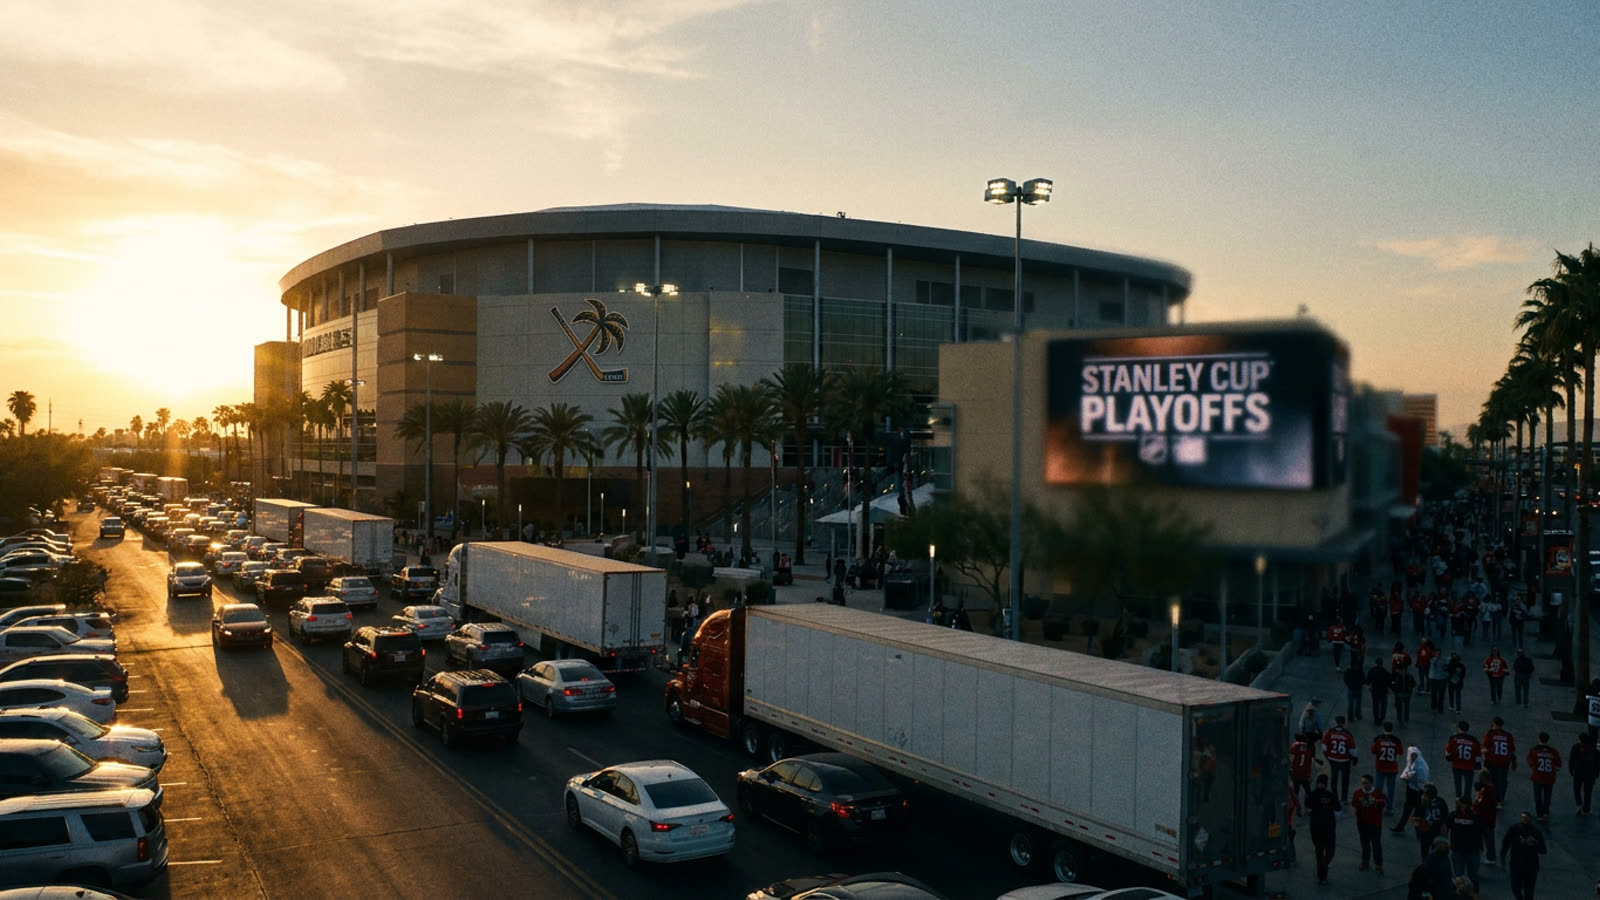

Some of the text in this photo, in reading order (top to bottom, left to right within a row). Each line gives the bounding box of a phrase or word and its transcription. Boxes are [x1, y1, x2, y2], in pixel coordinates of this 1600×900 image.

[1082, 360, 1270, 393] STANLEY CUP
[1080, 394, 1271, 433] PLAYOFFS
